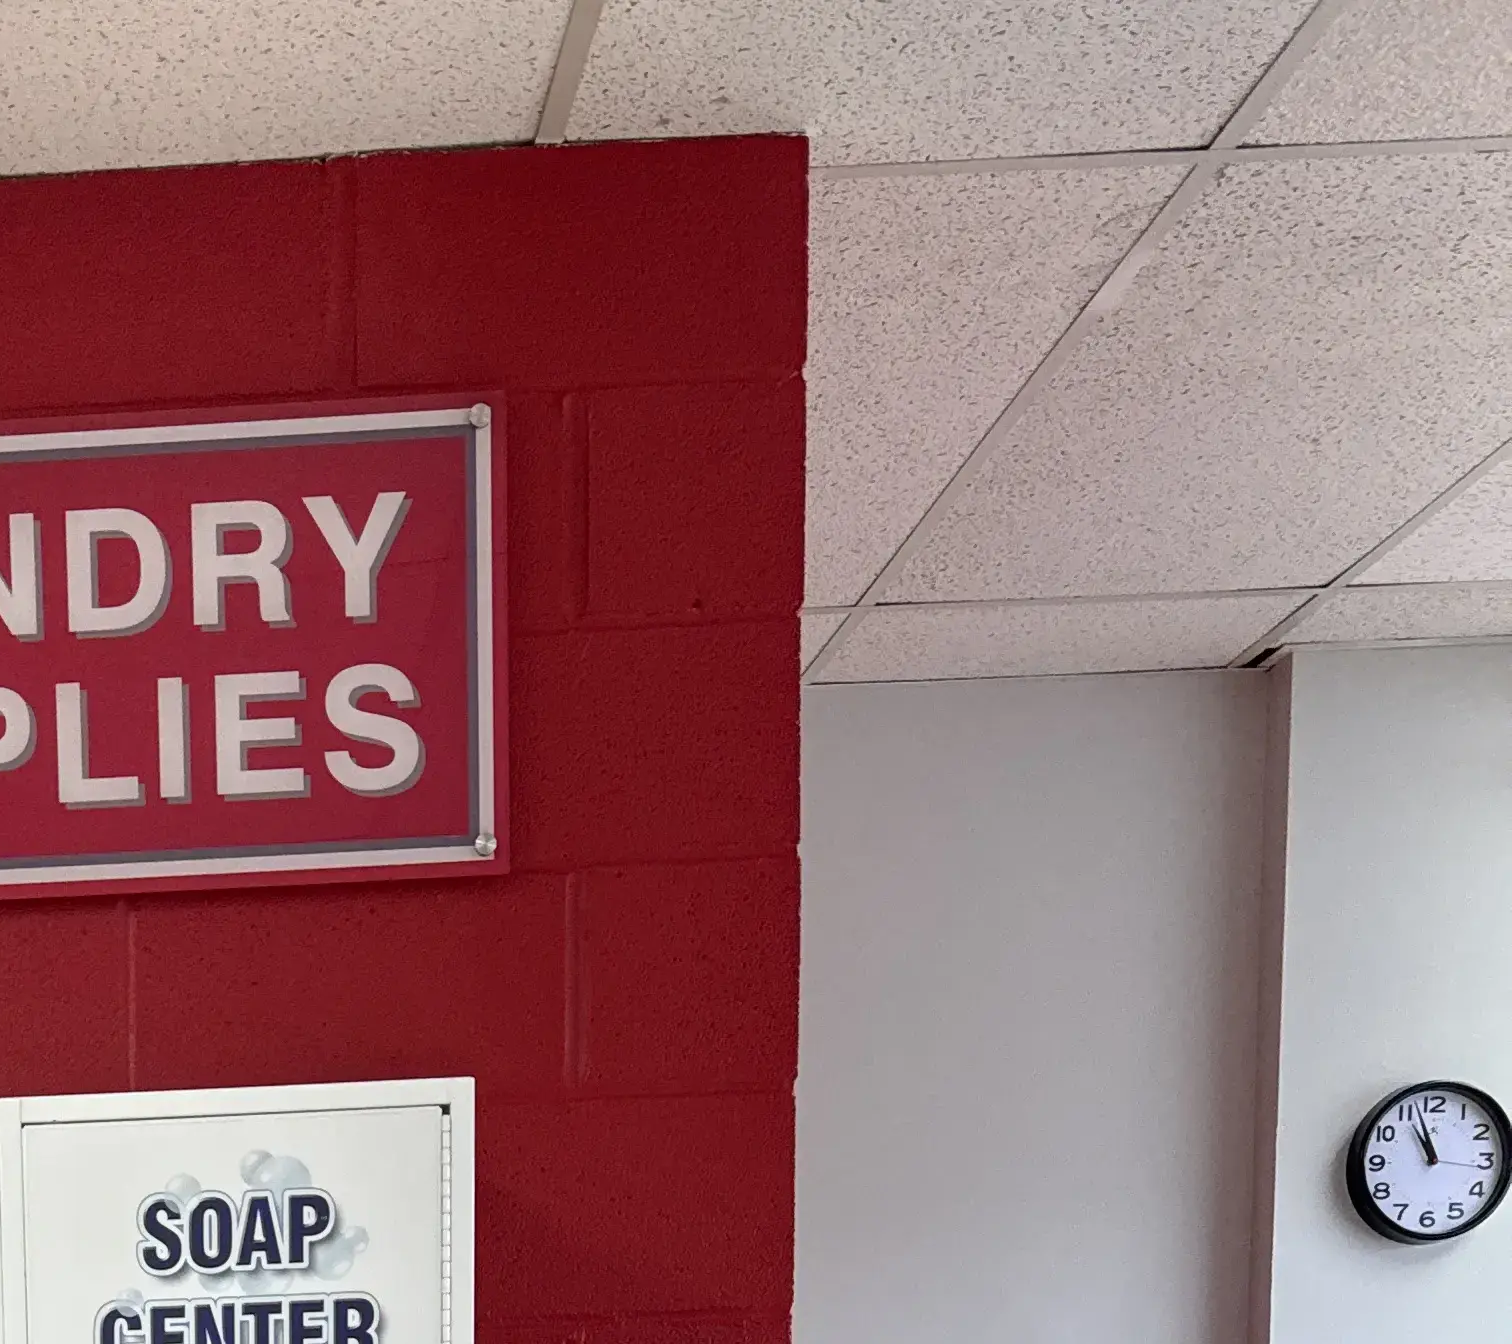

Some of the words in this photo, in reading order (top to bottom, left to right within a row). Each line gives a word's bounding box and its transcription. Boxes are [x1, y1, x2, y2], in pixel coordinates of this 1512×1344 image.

[1399, 1104, 1413, 1121] 11
[1423, 1096, 1447, 1113] 12
[1460, 1103, 1467, 1120] 1
[1376, 1125, 1396, 1142] 10
[1472, 1123, 1491, 1141] 2
[1368, 1154, 1386, 1172] 9
[1477, 1152, 1495, 1170] 3
[1372, 1182, 1391, 1200] 8
[1468, 1180, 1486, 1199] 4
[1392, 1203, 1410, 1221] 7
[1418, 1211, 1436, 1228] 6
[1446, 1202, 1465, 1220] 5
[140, 1192, 333, 1272] SOAP
